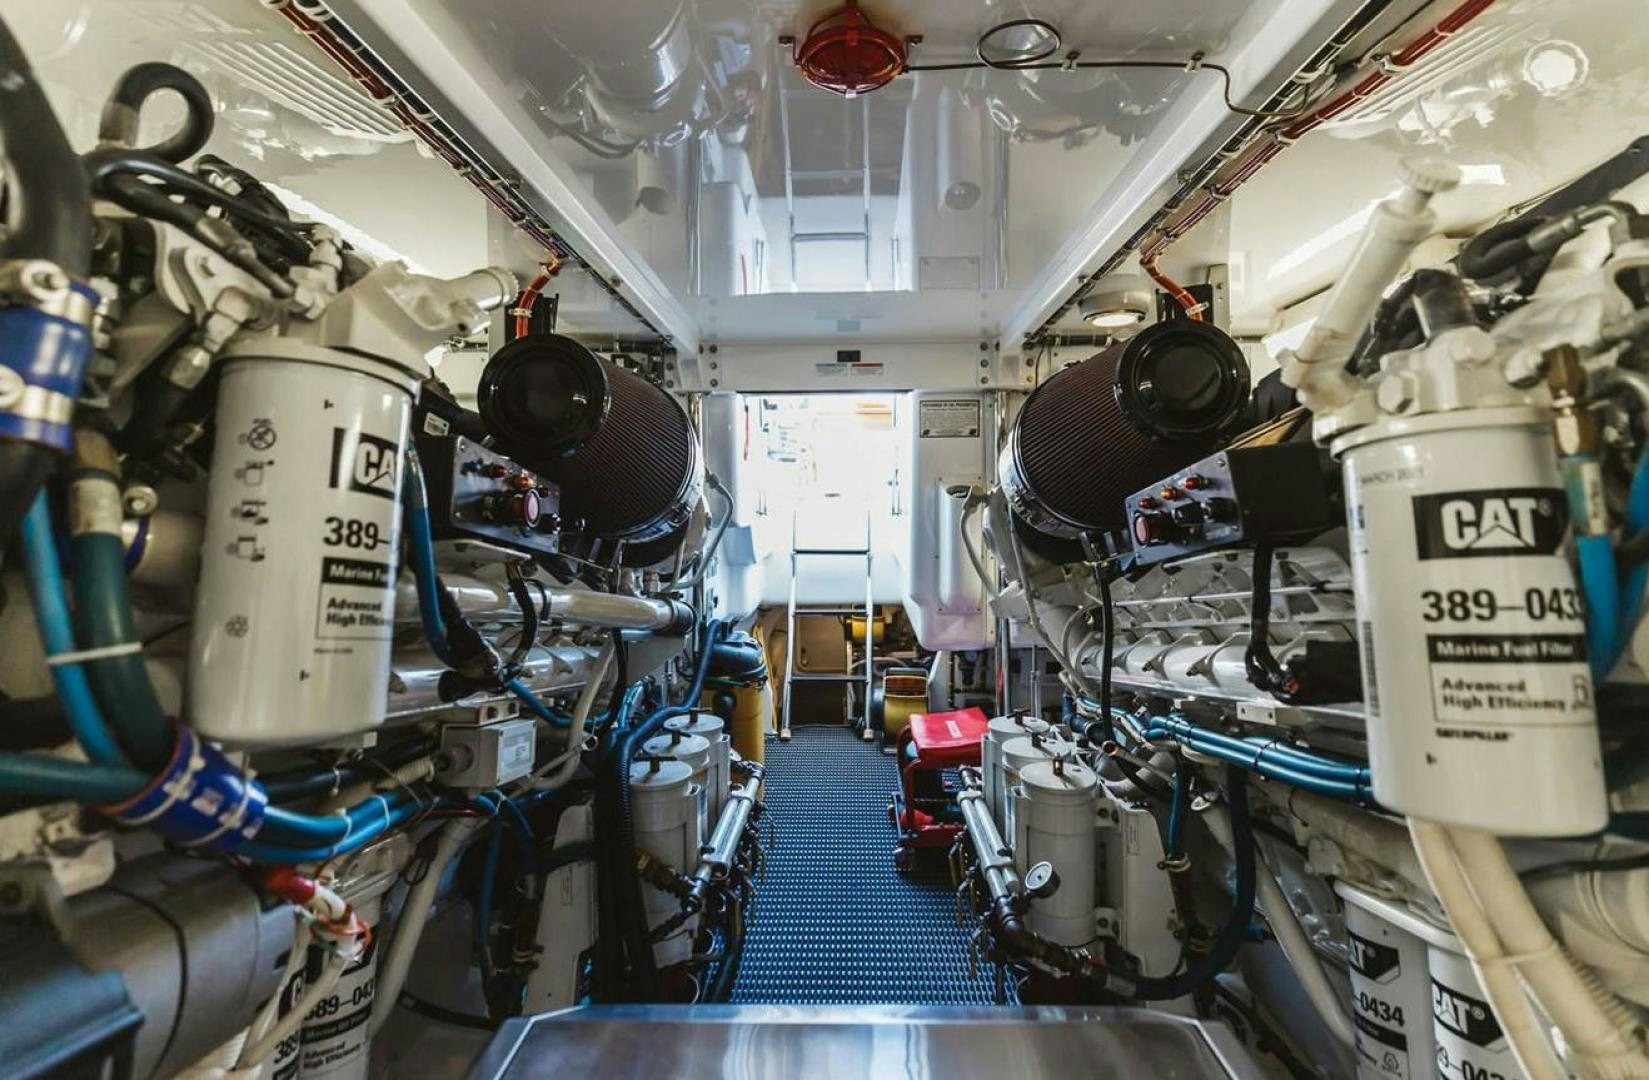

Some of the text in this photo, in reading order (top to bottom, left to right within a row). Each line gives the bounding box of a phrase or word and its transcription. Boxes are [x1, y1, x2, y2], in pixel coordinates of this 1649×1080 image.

[327, 596, 382, 612] Advanced
[326, 612, 356, 628] High
[1435, 640, 1499, 657] Marine
[1503, 640, 1538, 657] Fuel
[1442, 677, 1527, 693] Advanced
[1442, 696, 1567, 712] High Efficiency
